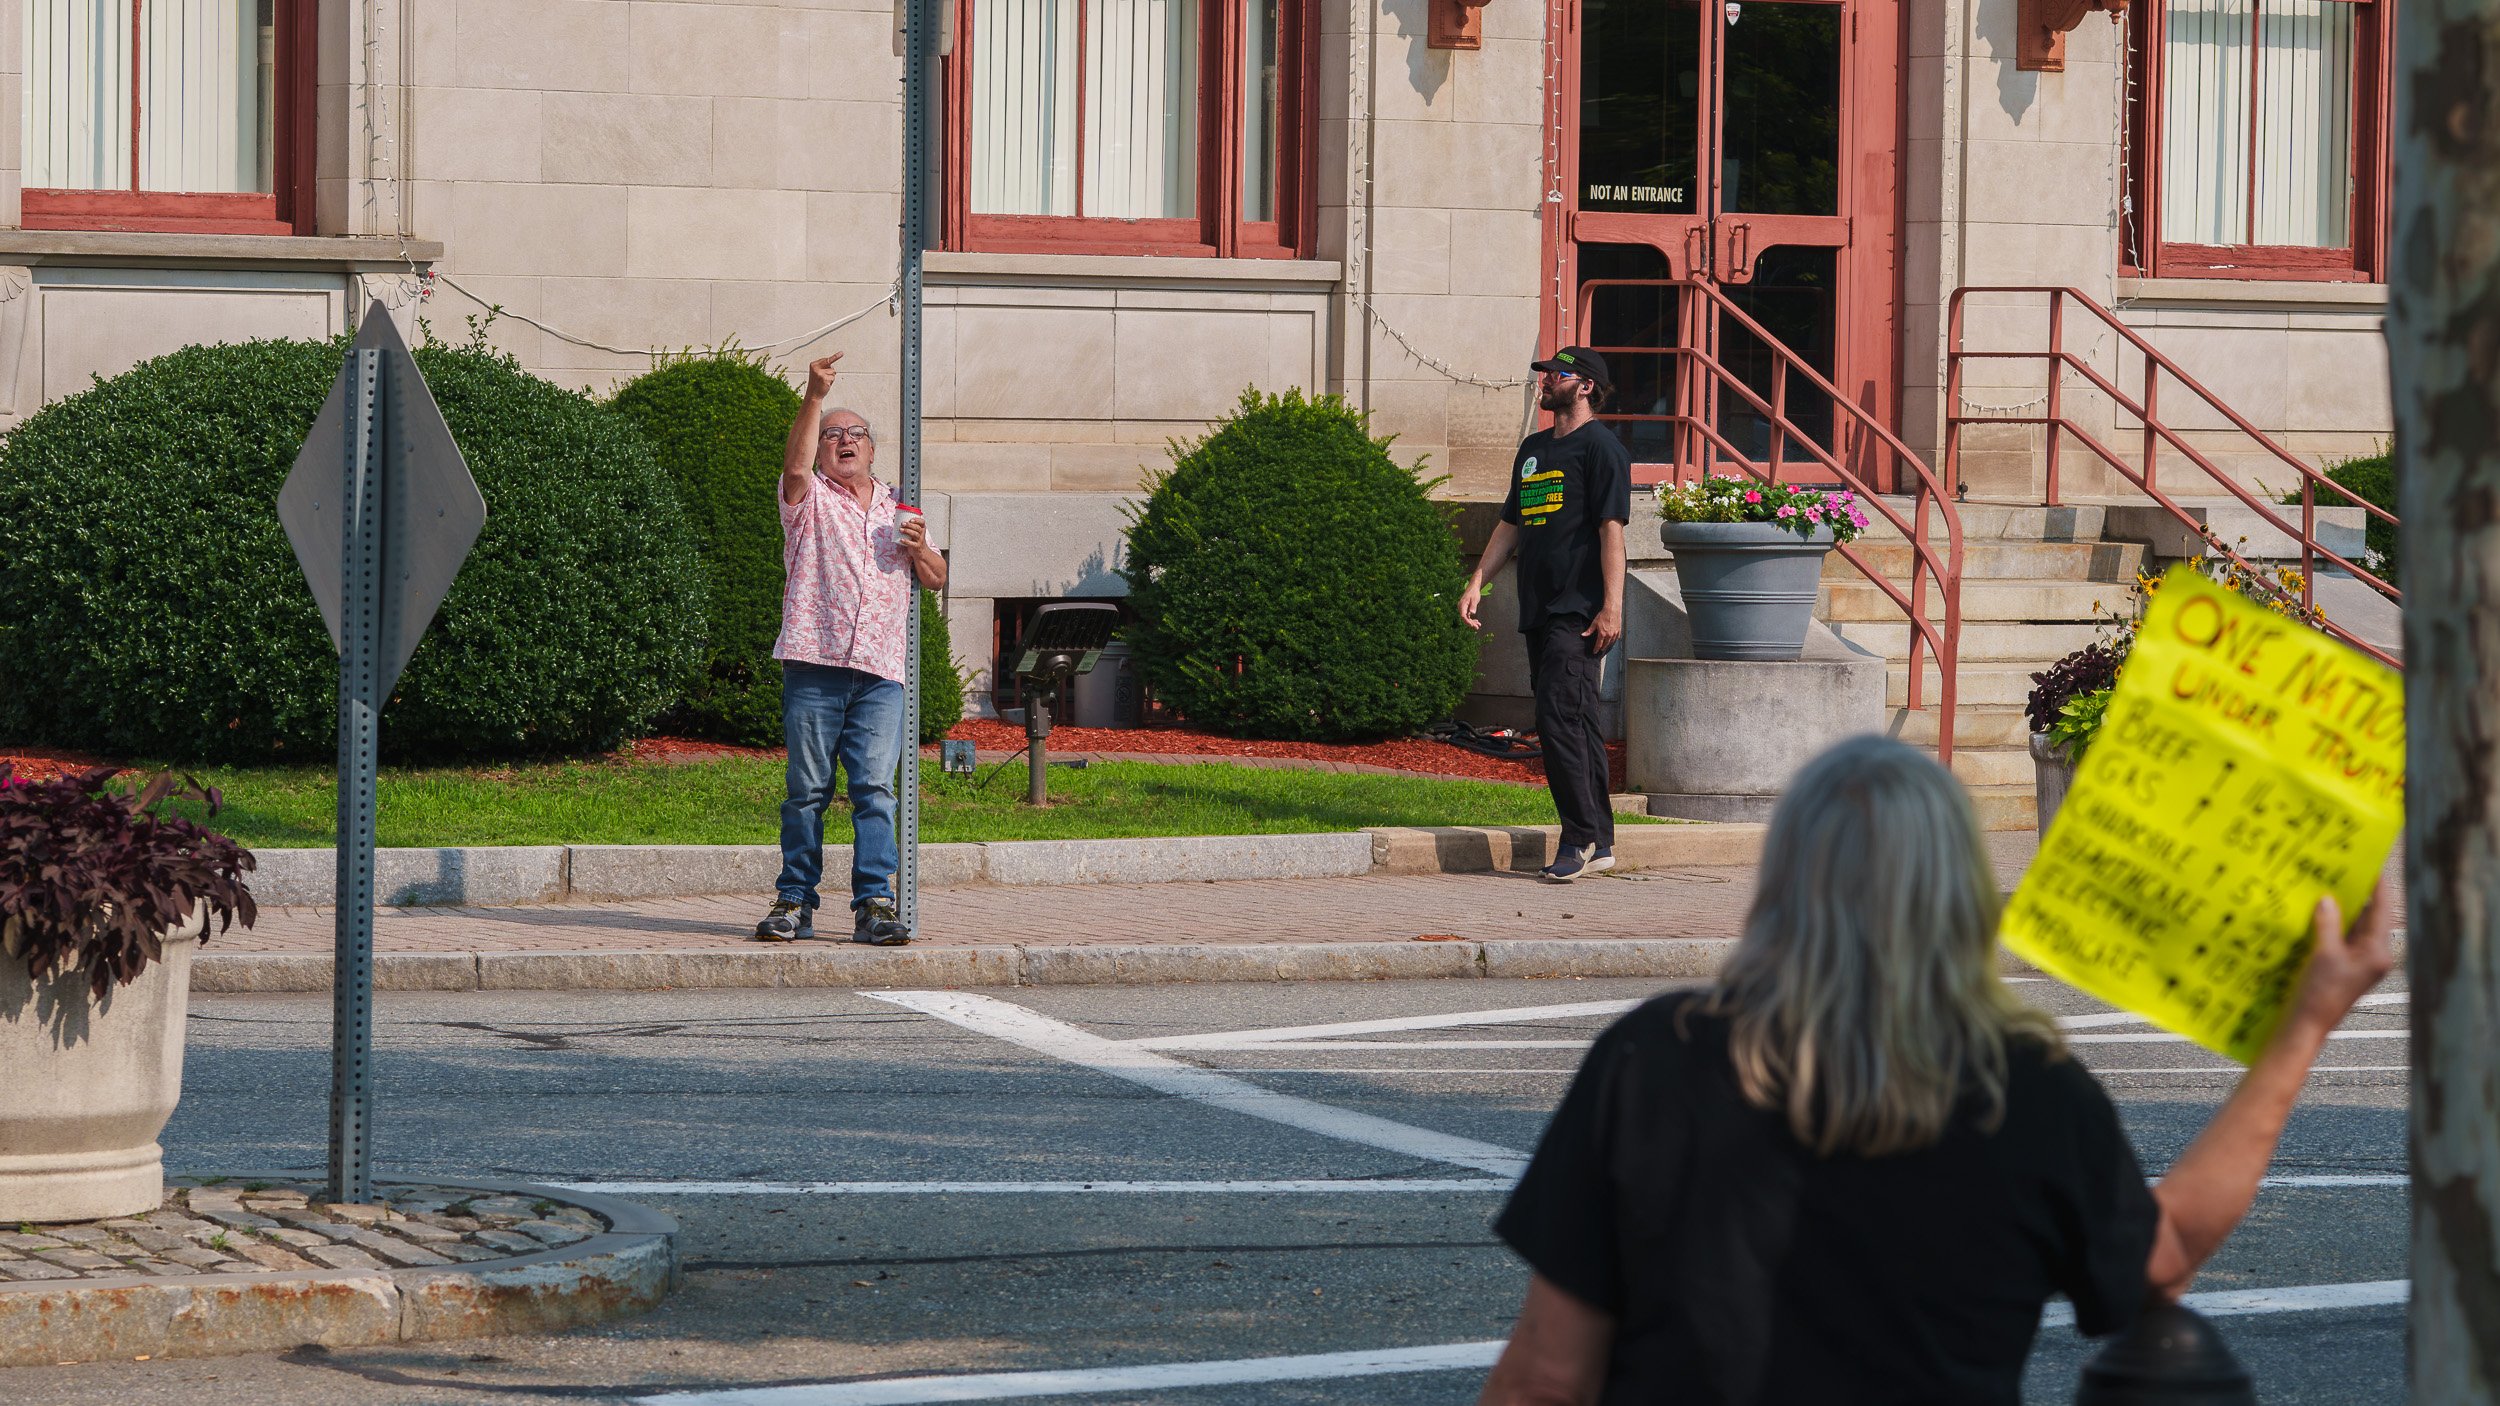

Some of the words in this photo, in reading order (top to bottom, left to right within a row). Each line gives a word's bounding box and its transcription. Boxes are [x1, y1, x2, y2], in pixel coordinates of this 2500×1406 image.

[1590, 184, 1611, 200] NOT
[1613, 185, 1628, 201] AN
[1631, 186, 1683, 203] ENTRANCE
[1546, 493, 1563, 502] FREE
[2171, 659, 2279, 741] UNDER
[2172, 593, 2284, 676] ONE
[2273, 649, 2405, 749] NATIO
[2114, 695, 2199, 766] BEEF
[2093, 749, 2166, 809] GAS
[2053, 823, 2210, 927] HEALTHCARE
[2066, 784, 2199, 873] CHILDCARE
[2227, 875, 2289, 917] 5%
[2015, 899, 2148, 981] MEDICARE
[2034, 862, 2168, 948] ELECTRIC
